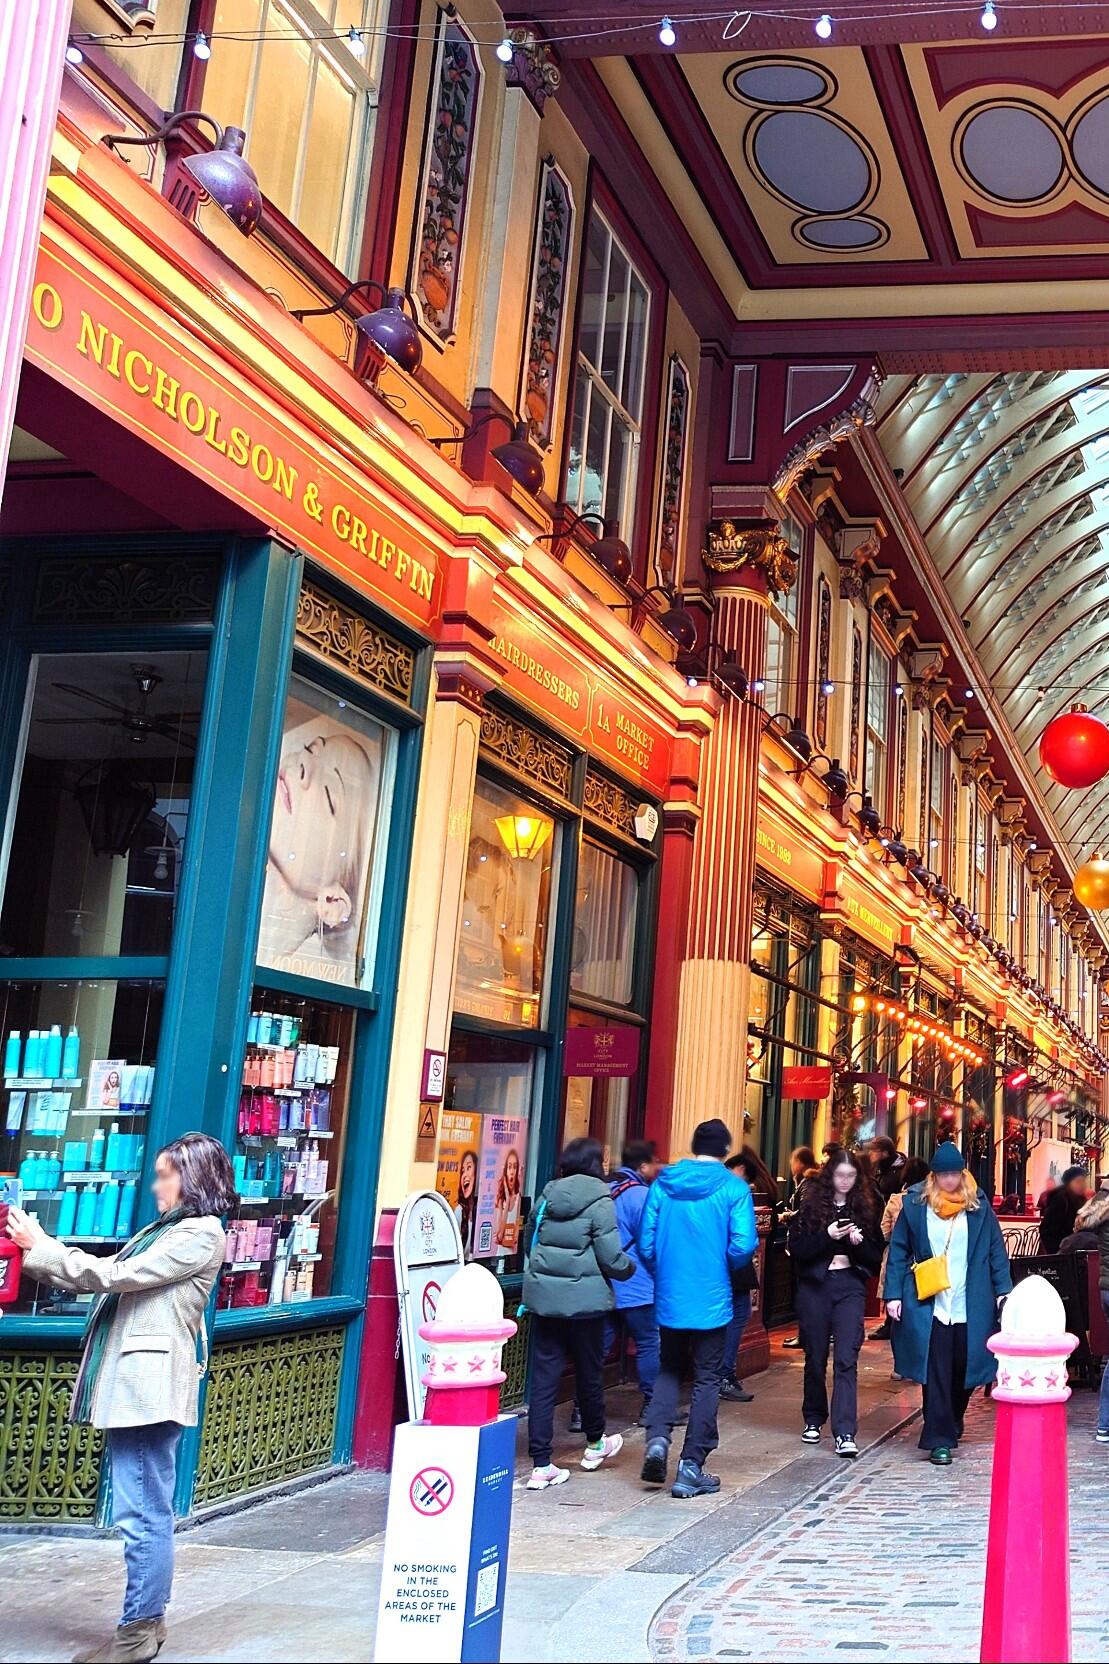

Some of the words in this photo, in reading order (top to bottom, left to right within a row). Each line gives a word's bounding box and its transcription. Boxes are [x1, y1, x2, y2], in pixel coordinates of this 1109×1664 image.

[76, 310, 299, 501] NICHOLSON
[302, 482, 324, 523] &
[331, 504, 435, 603] GRIFFIN
[616, 711, 655, 753] MARKET
[616, 735, 650, 770] OFFICE
[491, 1118, 509, 1131] PERFECT
[394, 1564, 409, 1573] NO
[411, 1564, 457, 1573] SMOKING
[407, 1576, 417, 1585] IN
[420, 1576, 439, 1585] THE
[396, 1588, 449, 1598] ENCLOSED
[384, 1601, 418, 1610] AREAS
[420, 1601, 435, 1610] OF
[437, 1602, 457, 1611] THE
[400, 1613, 441, 1623] MARKET
